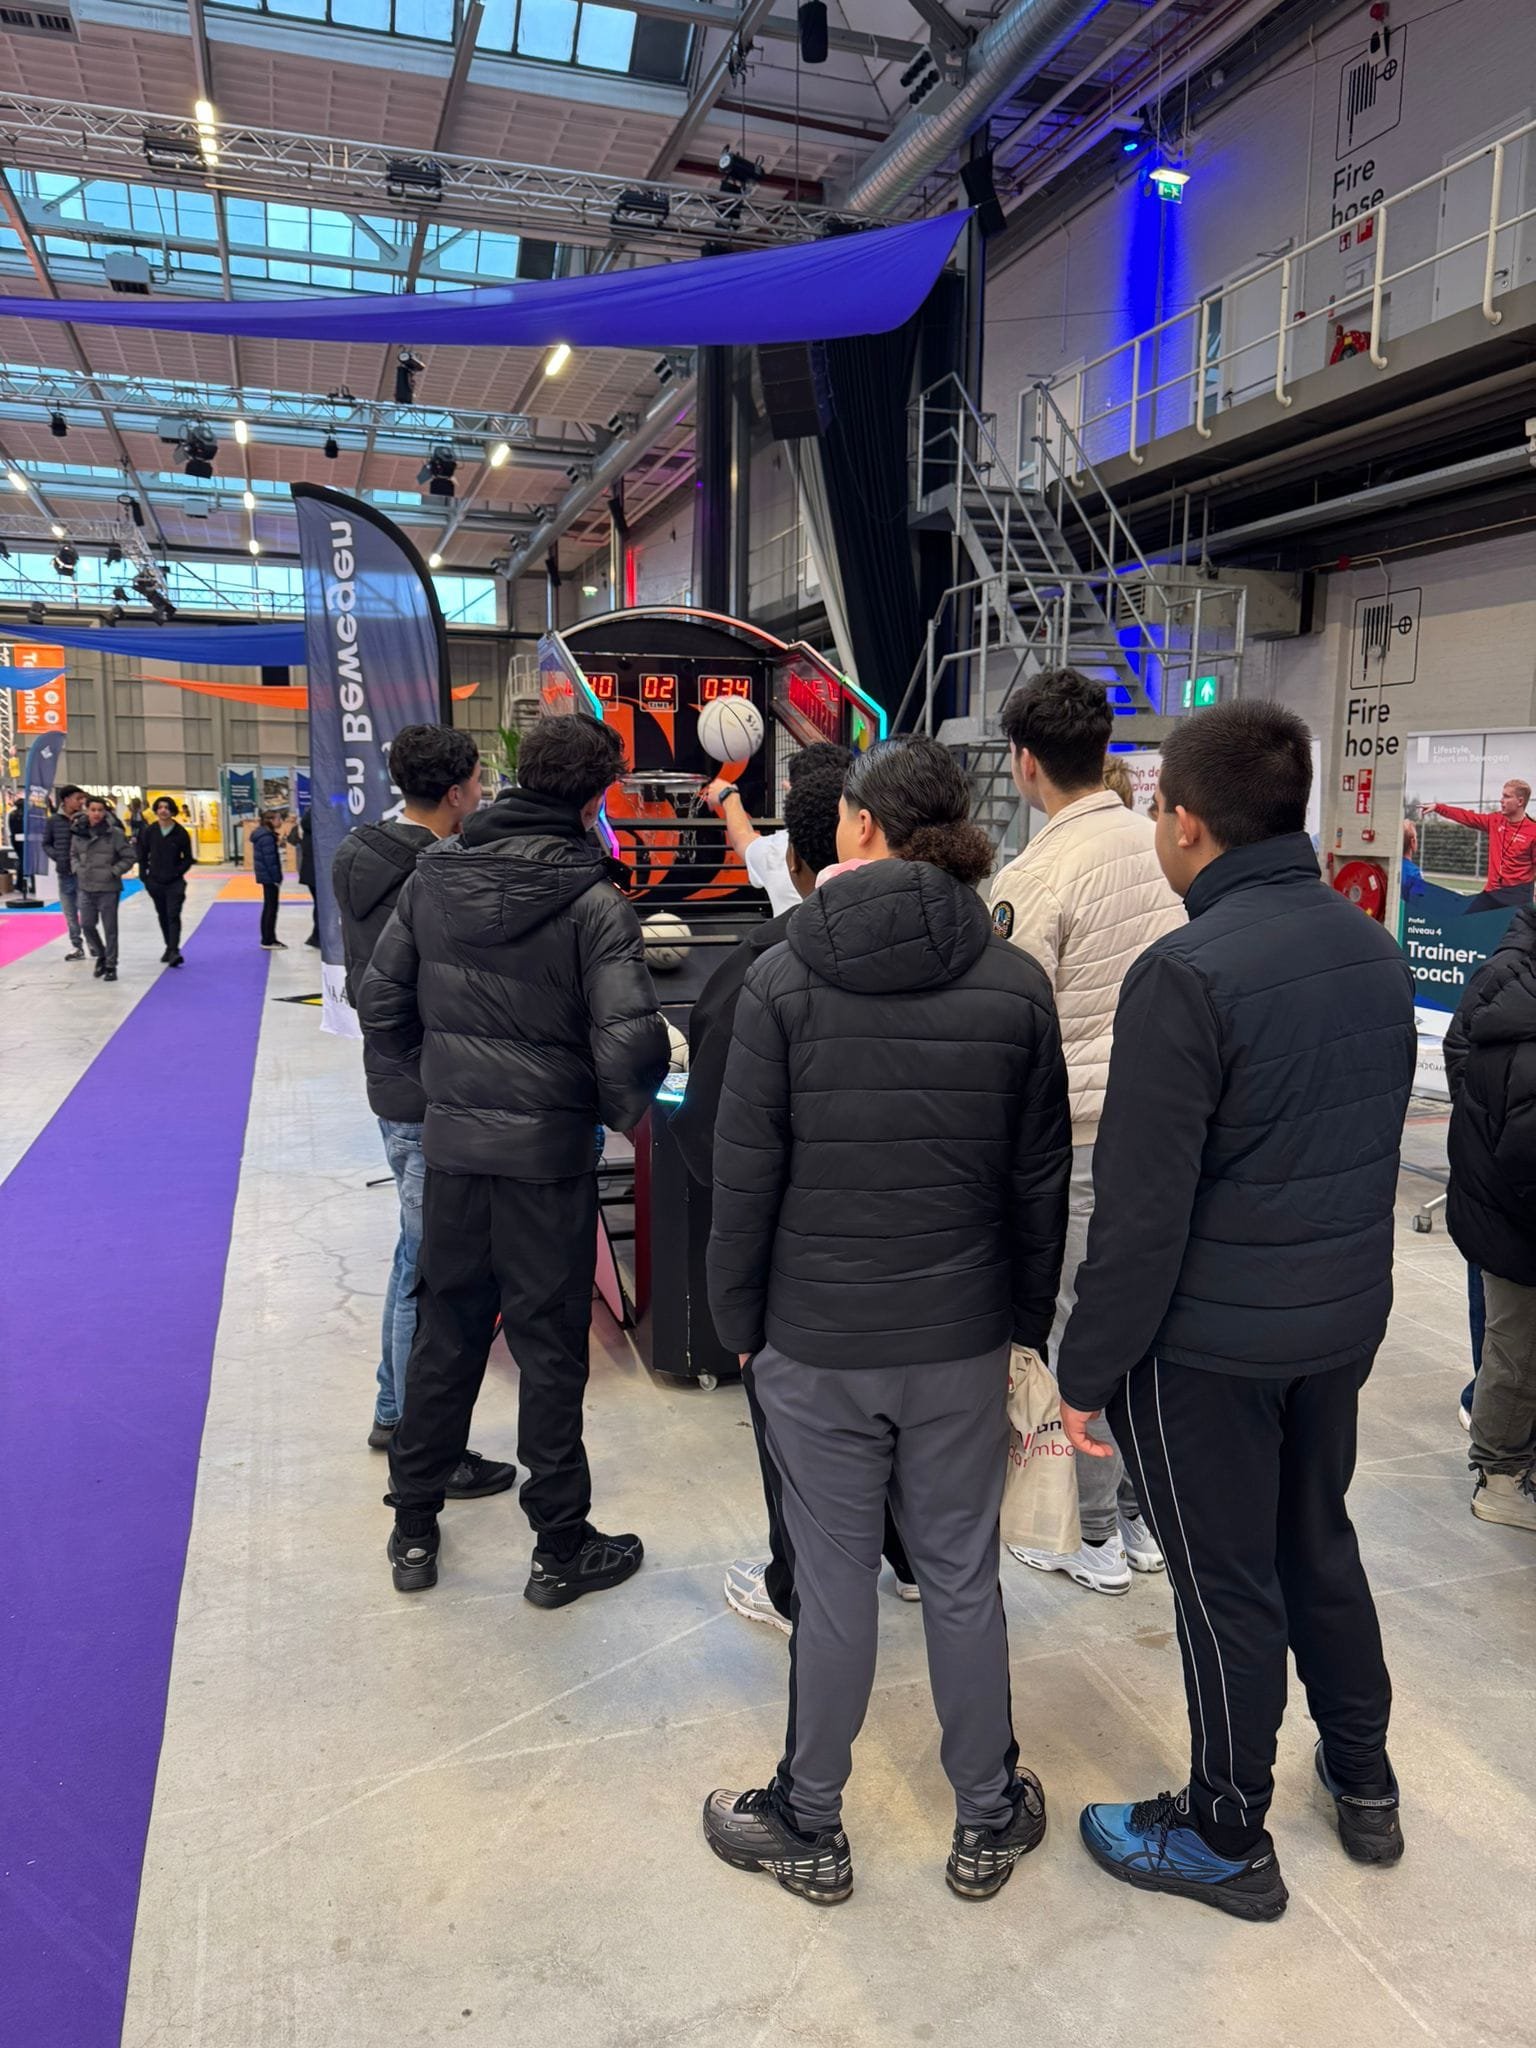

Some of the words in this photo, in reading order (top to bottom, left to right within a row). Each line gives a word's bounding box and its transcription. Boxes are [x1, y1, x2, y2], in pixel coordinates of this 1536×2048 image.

[1333, 160, 1375, 200] Fire
[1331, 188, 1384, 230] hose
[22, 652, 40, 724] Teniek
[644, 676, 674, 698] 02
[704, 678, 748, 700] 034
[1347, 698, 1390, 726] Fire
[1344, 729, 1399, 758] hose
[1408, 926, 1435, 935] niveau
[1436, 928, 1442, 936] 4
[1407, 940, 1487, 964] Trainer-
